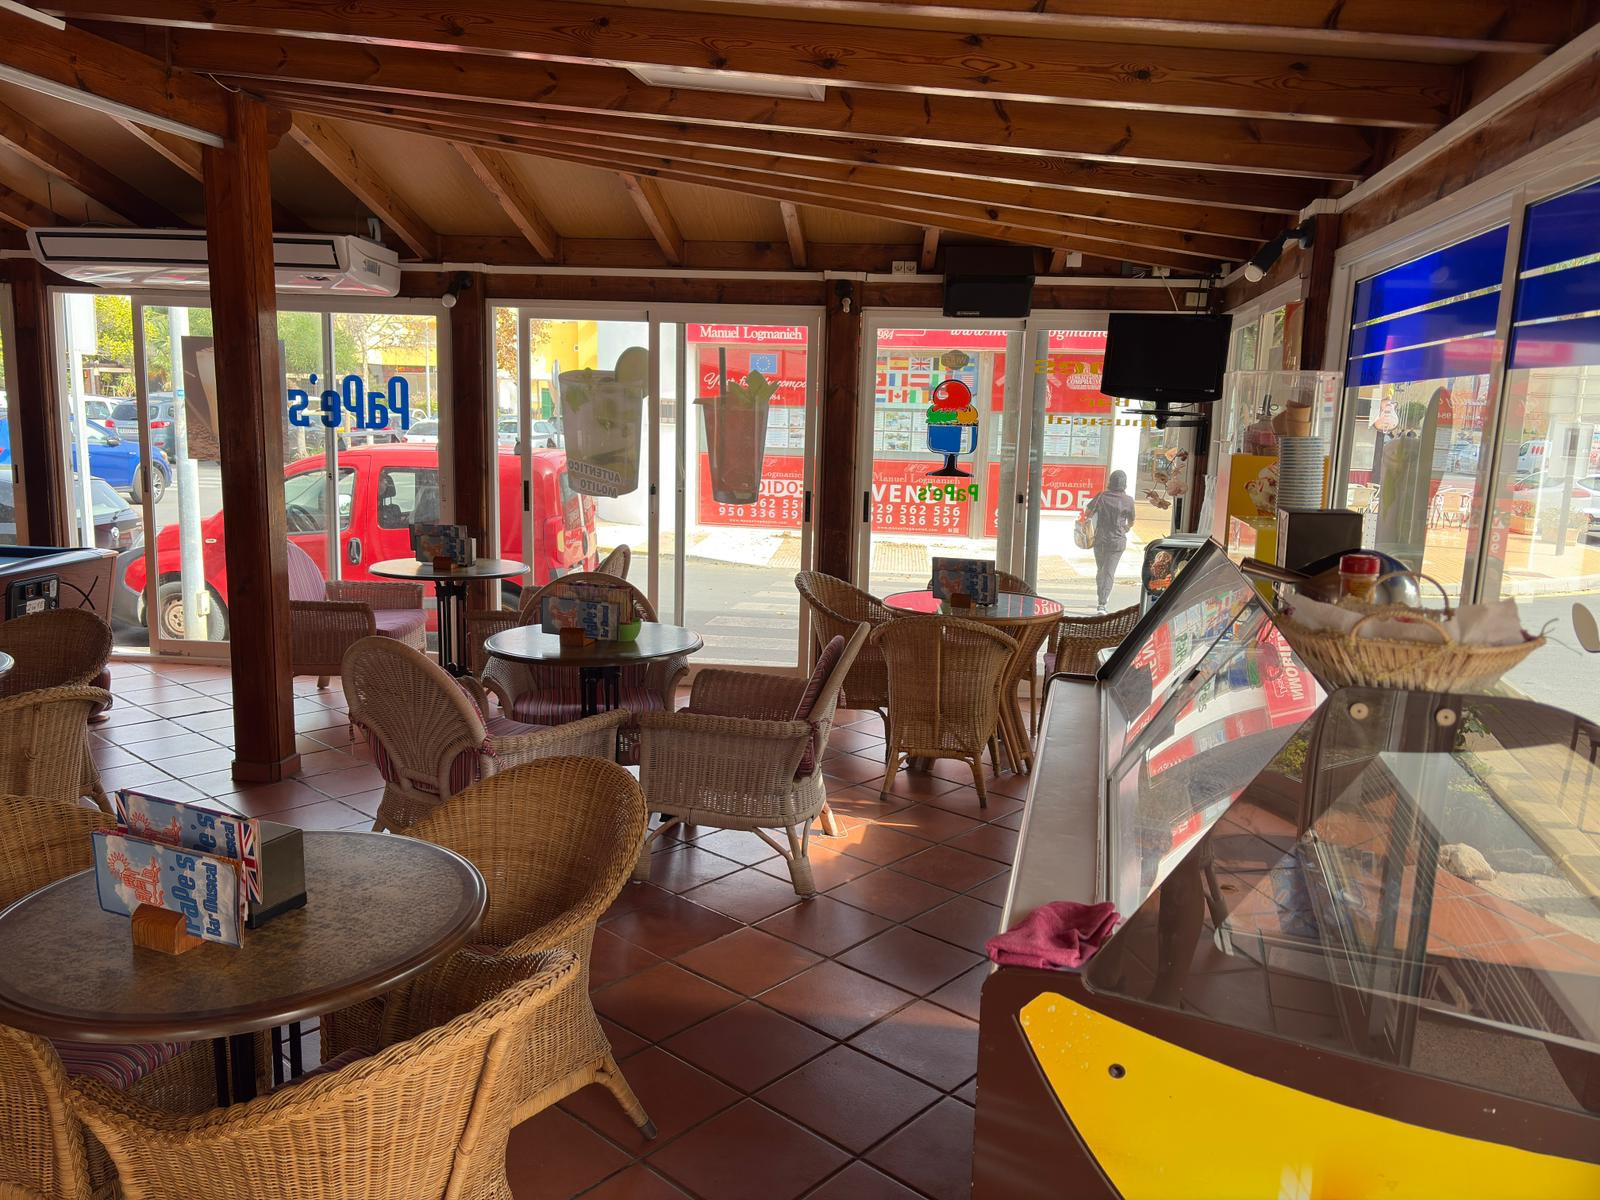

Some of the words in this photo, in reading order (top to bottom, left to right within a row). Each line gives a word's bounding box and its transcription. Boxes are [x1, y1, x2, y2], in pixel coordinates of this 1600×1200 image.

[700, 325, 740, 339] Manuel
[900, 505, 927, 516] 562
[933, 507, 961, 517] 556
[899, 515, 926, 526] 336
[932, 517, 960, 528] 597
[201, 861, 219, 914] Musical
[206, 913, 222, 938] Bar
